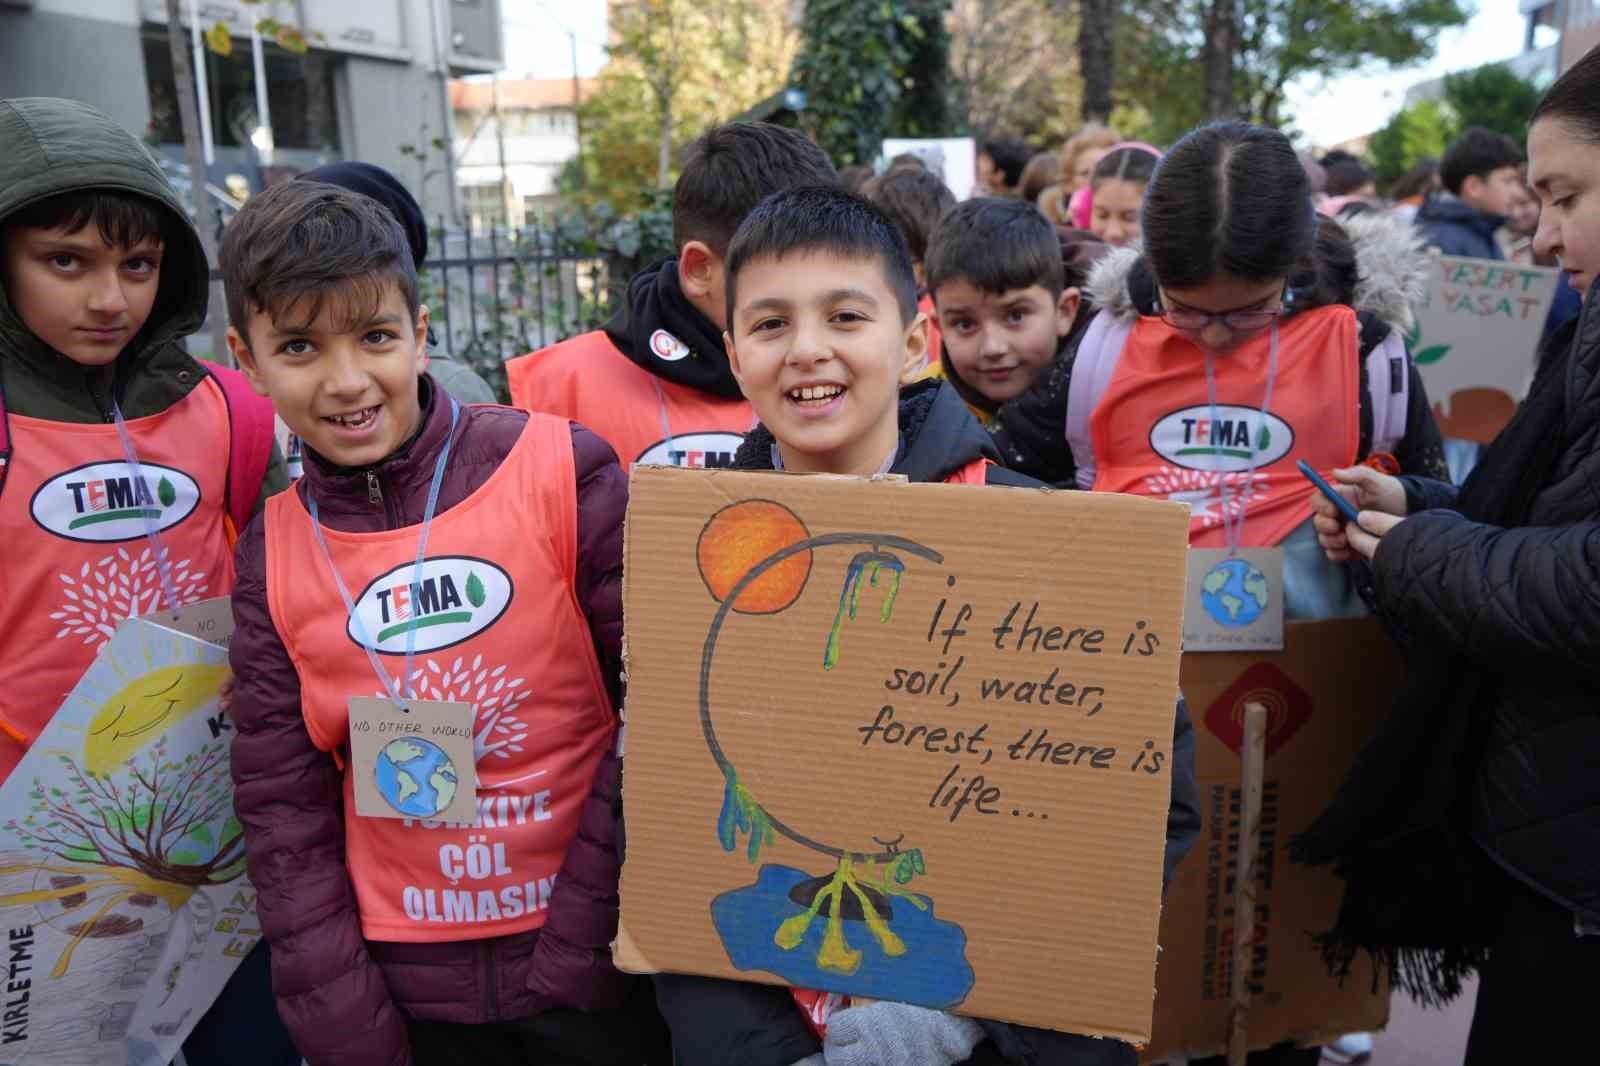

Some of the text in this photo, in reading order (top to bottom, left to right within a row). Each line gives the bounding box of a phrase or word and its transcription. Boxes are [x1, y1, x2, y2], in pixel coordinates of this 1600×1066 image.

[1182, 419, 1250, 448] TEMA
[66, 476, 154, 514] TEMA
[376, 573, 462, 624] TEMA
[197, 617, 216, 632] NO
[993, 602, 1105, 653] there
[1122, 620, 1160, 656] is
[885, 655, 1105, 716] soil, water,
[353, 721, 471, 737] NO OTHER WORLD
[858, 705, 1165, 774] forest, there is
[439, 836, 512, 885] ÇÖL
